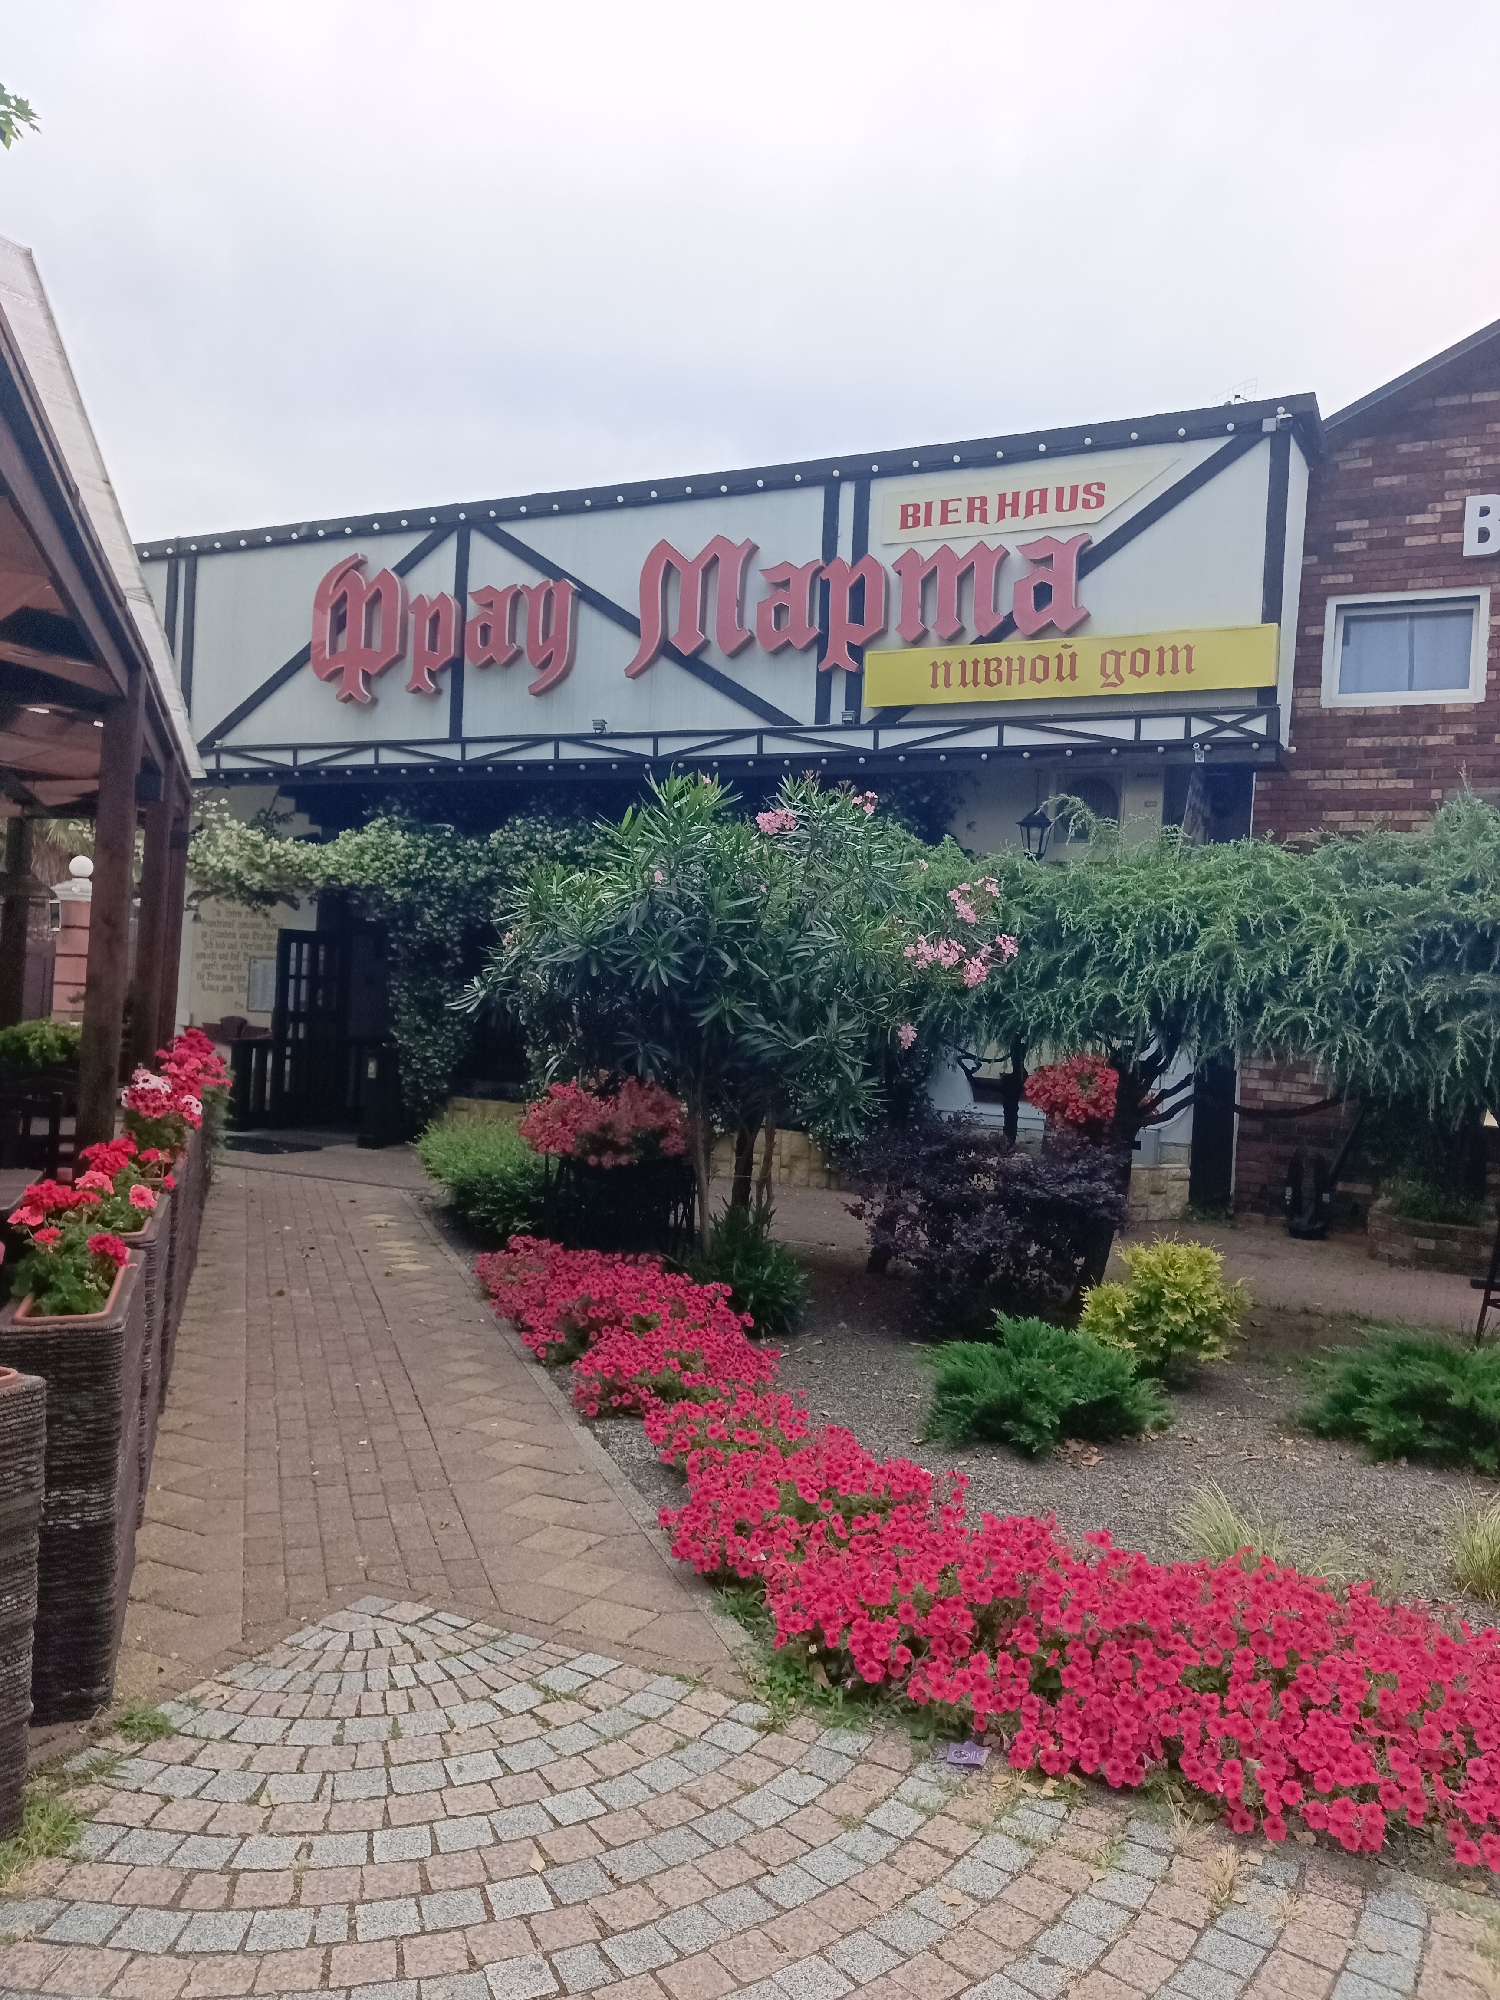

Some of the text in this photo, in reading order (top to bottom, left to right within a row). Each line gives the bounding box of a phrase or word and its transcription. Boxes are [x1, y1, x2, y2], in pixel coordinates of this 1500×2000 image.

[899, 481, 1106, 530] BIERHAUS
[310, 532, 1093, 704] Фрау Марта
[929, 643, 1197, 690] пивной дом
